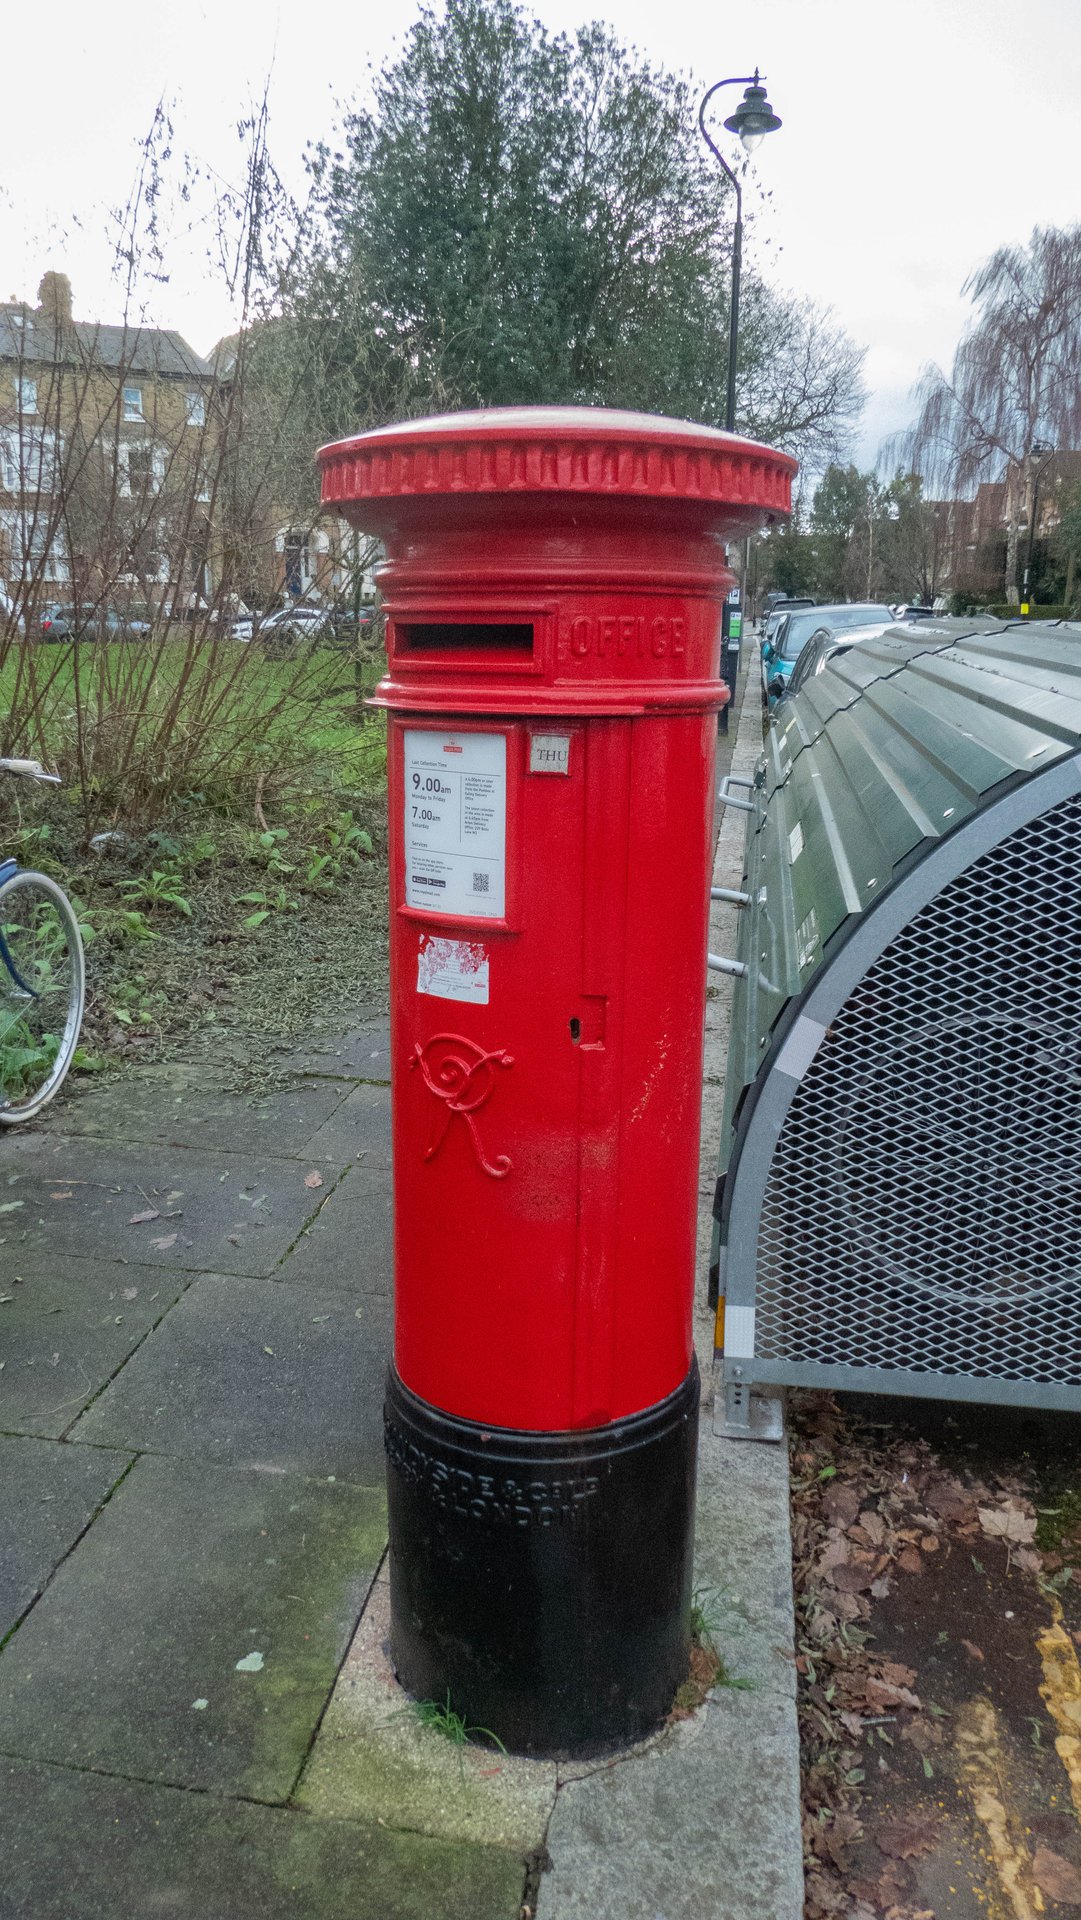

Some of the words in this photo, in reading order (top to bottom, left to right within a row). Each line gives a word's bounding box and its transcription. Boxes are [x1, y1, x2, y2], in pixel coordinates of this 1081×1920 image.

[571, 615, 685, 658] OFFICE
[537, 749, 567, 762] THU
[412, 773, 452, 794] 9.00am
[412, 806, 440, 822] 7.00am
